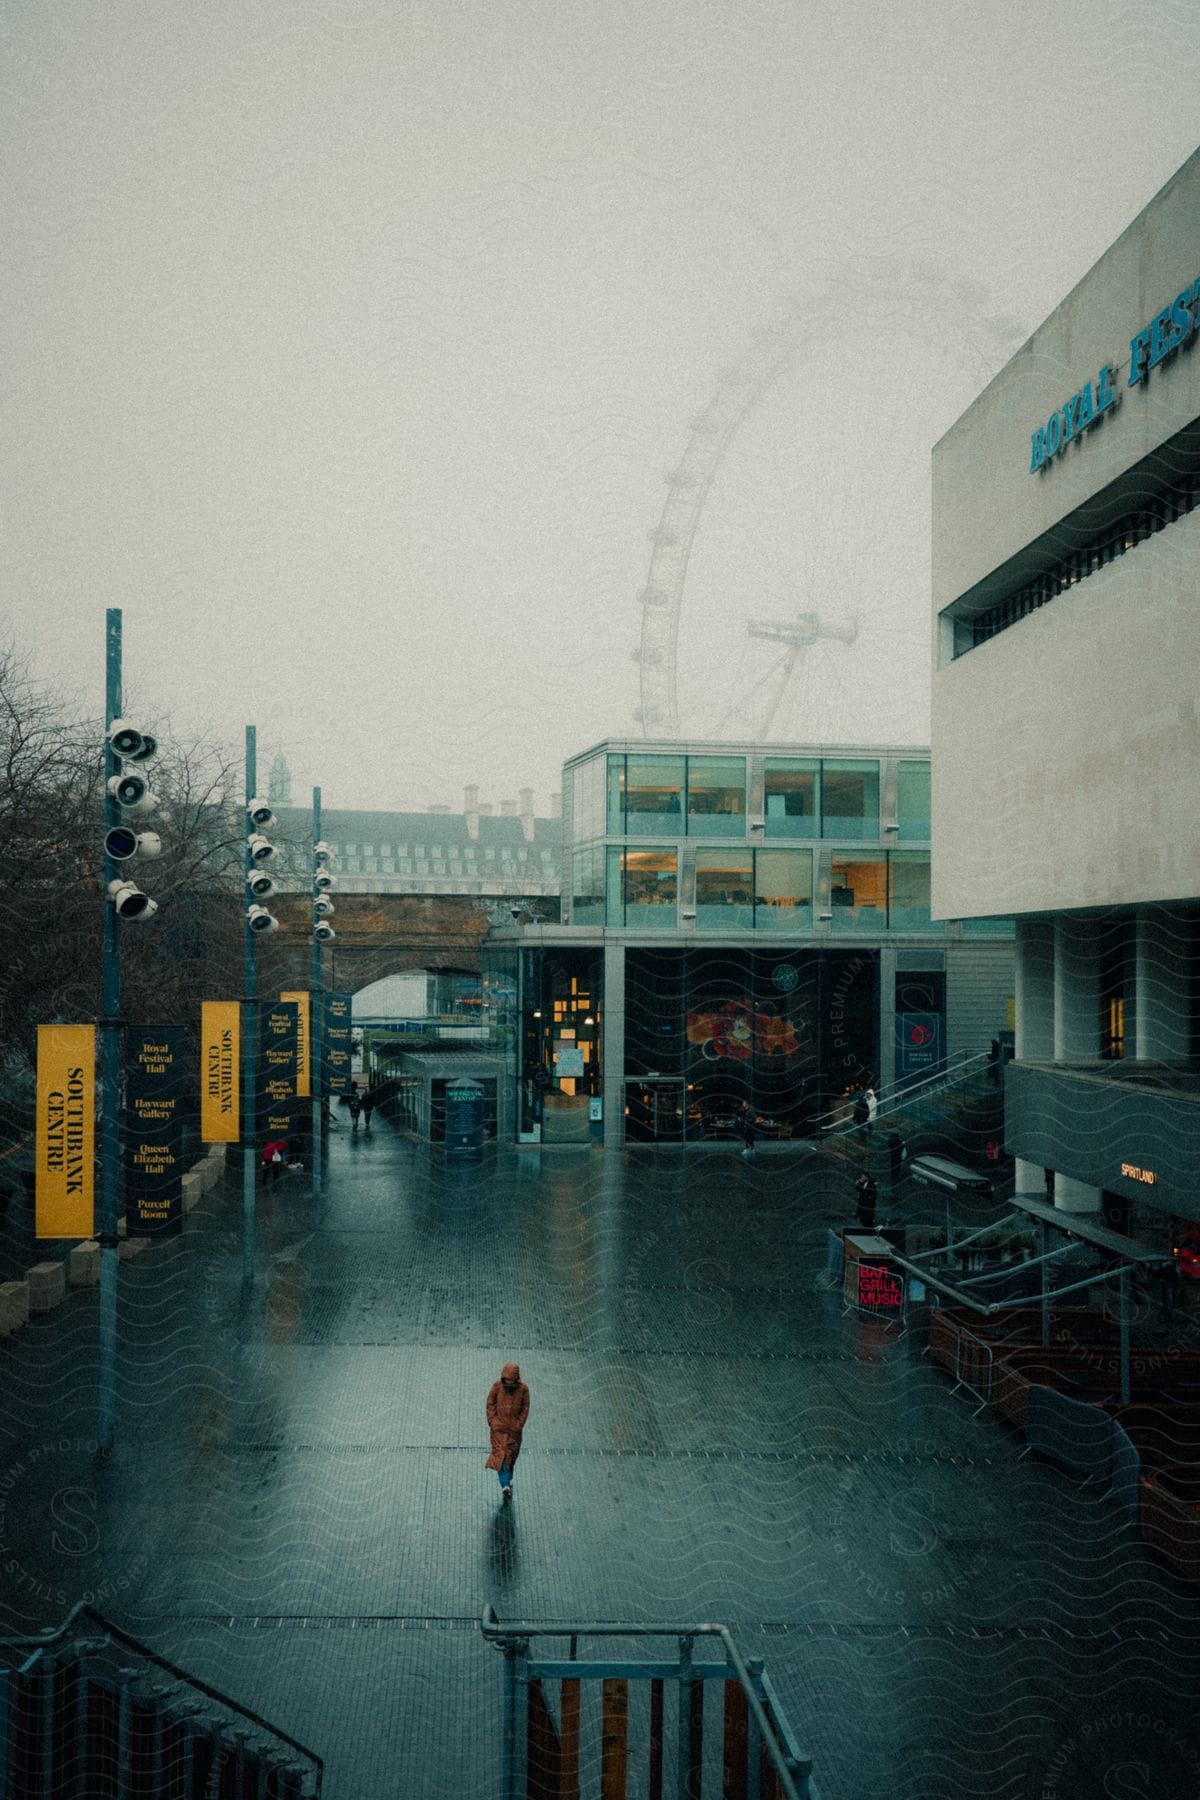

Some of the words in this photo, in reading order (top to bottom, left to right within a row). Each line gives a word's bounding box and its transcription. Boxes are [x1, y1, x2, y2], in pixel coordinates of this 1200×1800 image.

[1029, 362, 1117, 474] ROYAL
[143, 1044, 169, 1054] Royal
[138, 1054, 173, 1063] Festival
[146, 1064, 166, 1073] Hall
[208, 1045, 220, 1099] CENTRE
[221, 1029, 233, 1113] SOUTHBANK
[134, 1099, 176, 1109] Hayward
[138, 1109, 172, 1120] Gallery
[47, 1091, 64, 1173] CENTRE
[66, 1067, 84, 1194] SOUTHBANK
[139, 1144, 169, 1154] Queen
[133, 1154, 176, 1163] Elizabeth
[144, 1165, 165, 1174] Hall
[137, 1200, 171, 1209] Purcell
[139, 1210, 168, 1219] Room
[859, 1265, 889, 1279] BAR
[859, 1279, 900, 1293] GRILL
[859, 1292, 904, 1306] MUSIC
